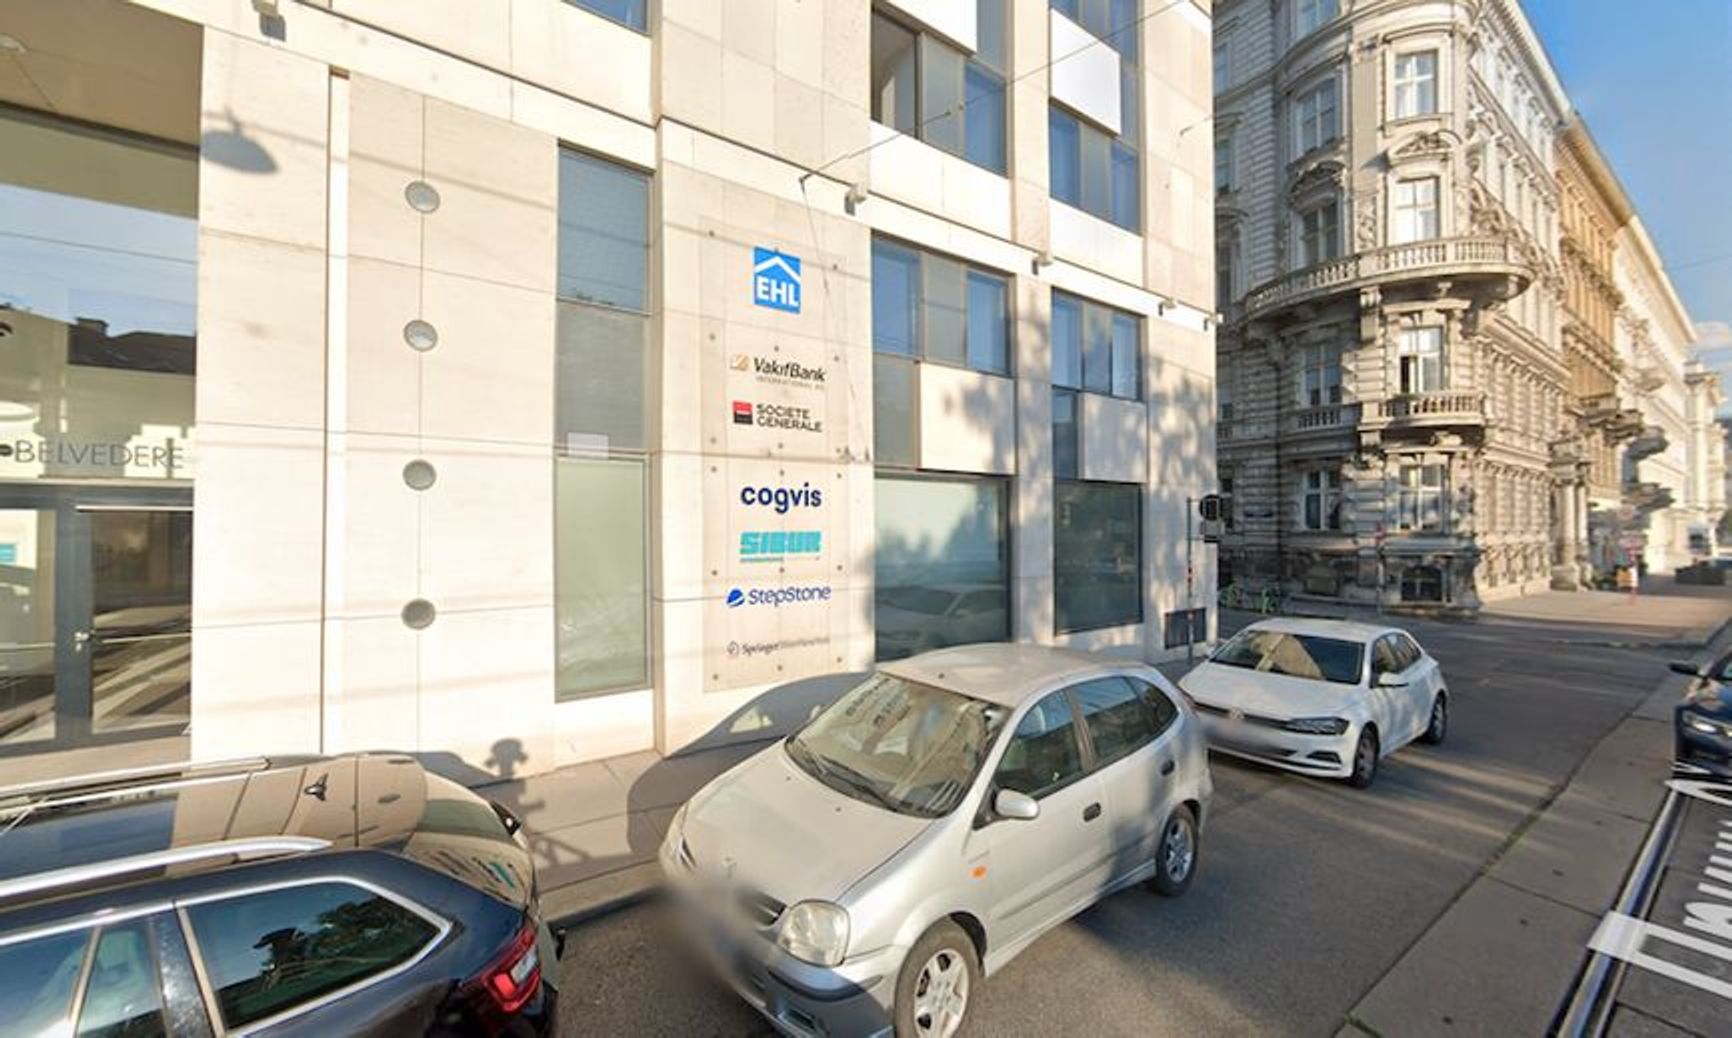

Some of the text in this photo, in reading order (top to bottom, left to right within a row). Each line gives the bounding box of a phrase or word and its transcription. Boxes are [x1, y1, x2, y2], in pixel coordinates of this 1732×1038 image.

[756, 276, 800, 308] EHL
[756, 403, 810, 420] SOCIETE
[756, 416, 823, 433] GENERALE
[14, 439, 184, 469] BELVEDERE
[740, 482, 823, 514] cogvis
[739, 531, 822, 555] SIBUR
[748, 586, 832, 608] StepStone
